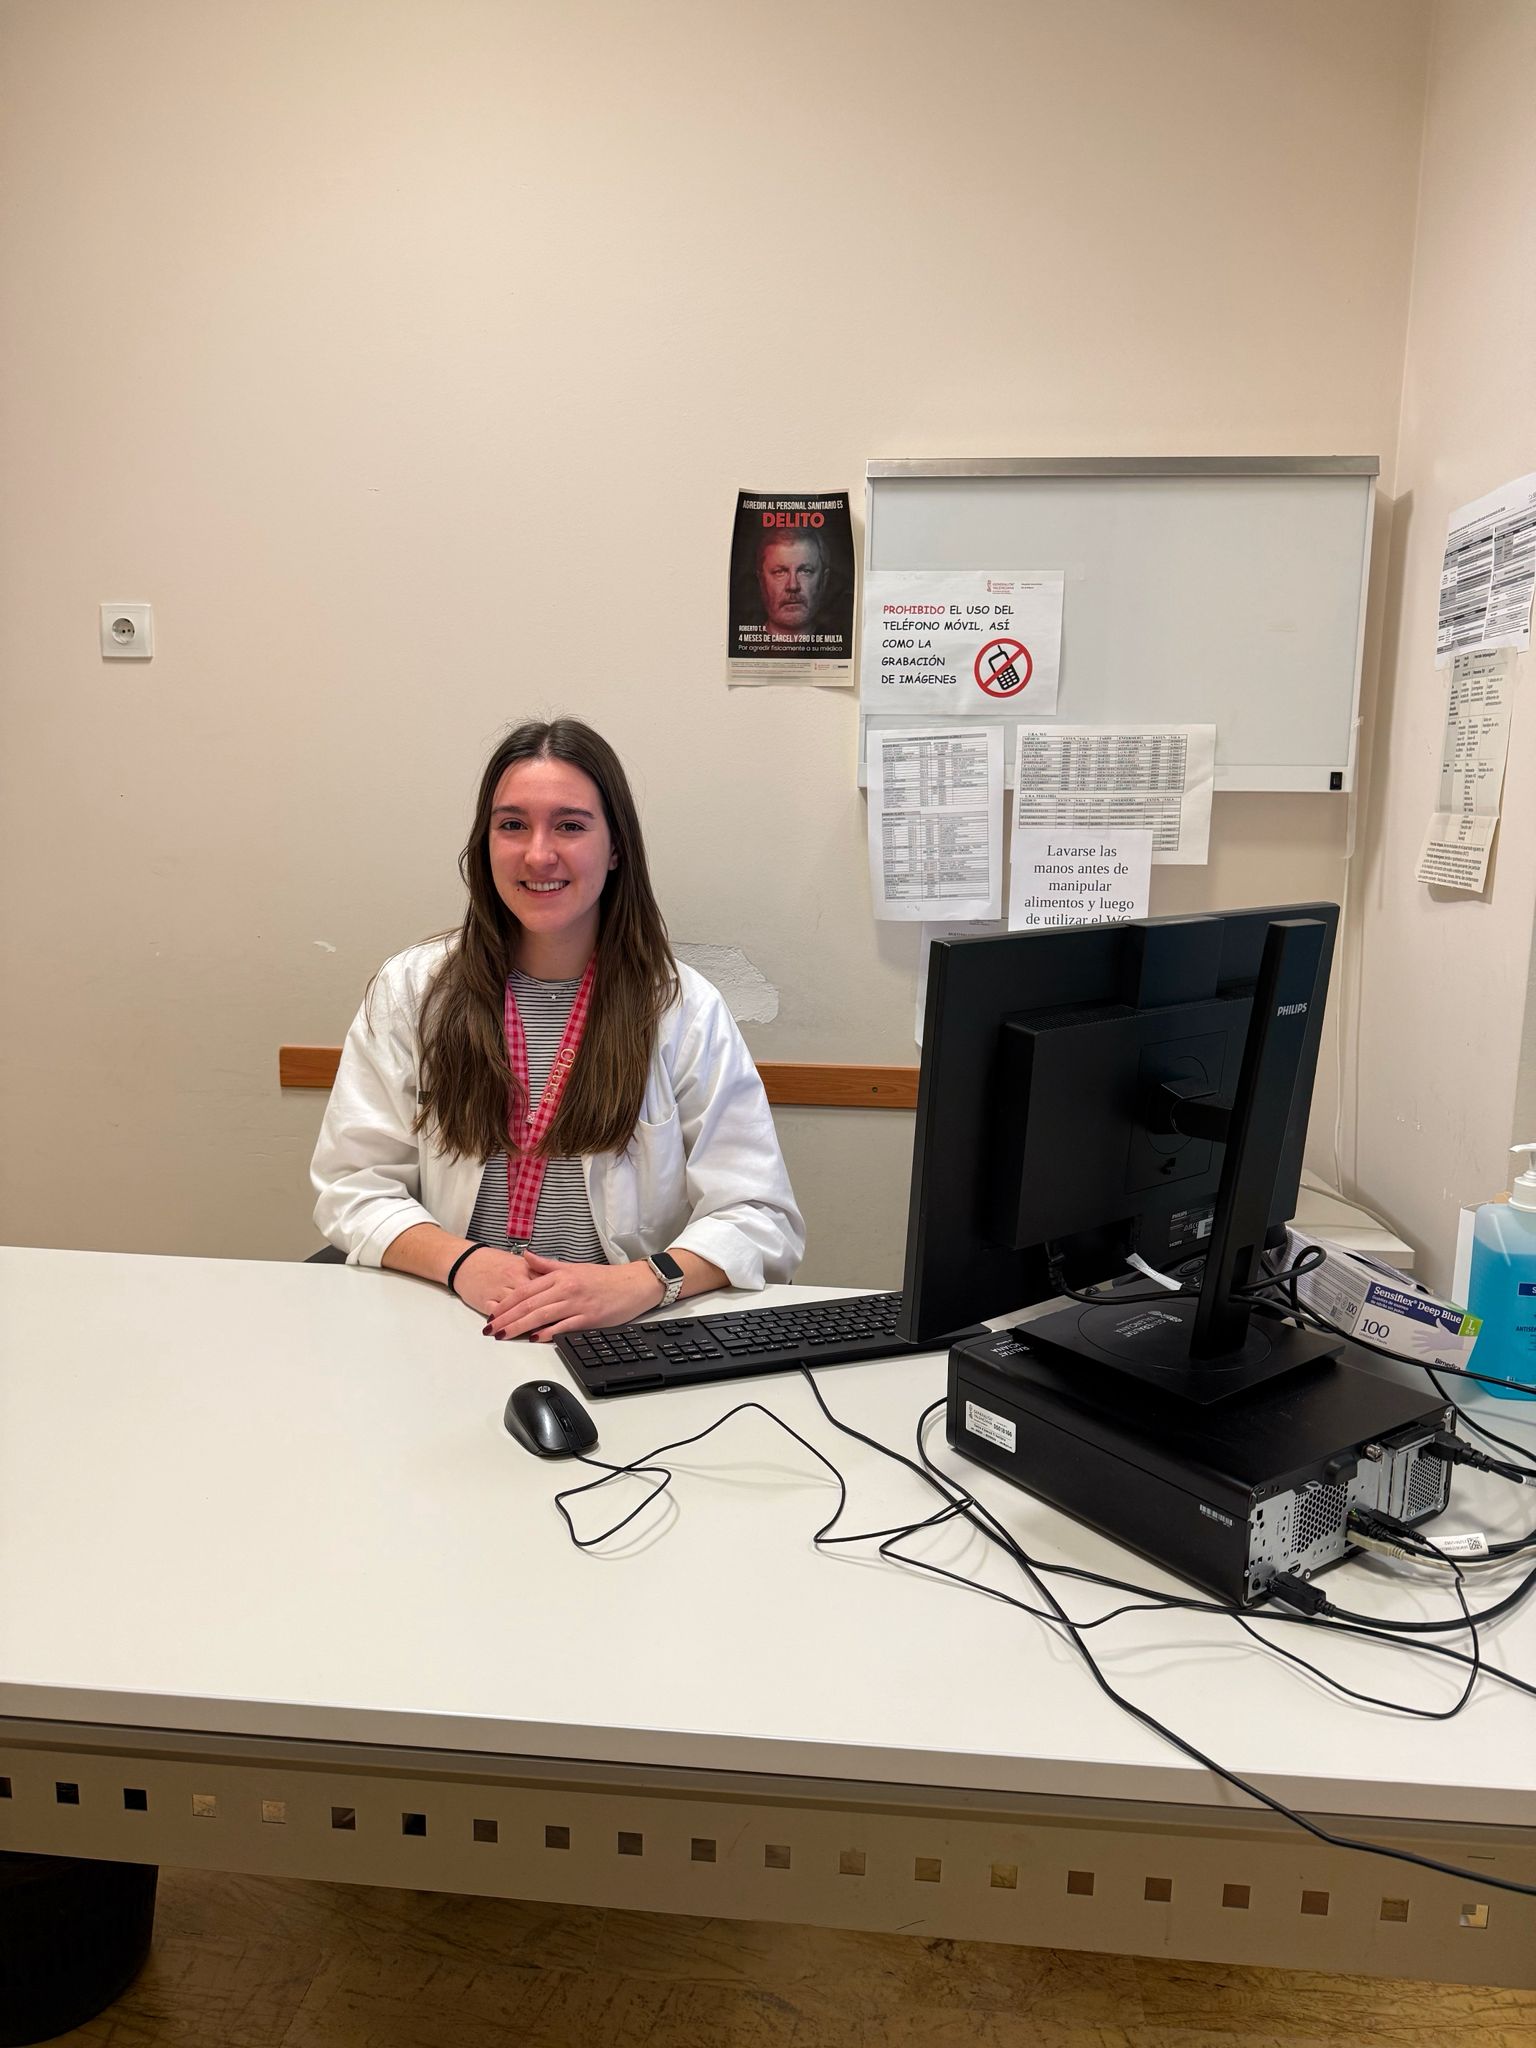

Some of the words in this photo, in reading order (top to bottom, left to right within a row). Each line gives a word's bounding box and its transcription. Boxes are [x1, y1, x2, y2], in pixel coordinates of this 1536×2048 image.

[743, 500, 766, 510] AGREDIR
[768, 502, 776, 510] AL
[776, 501, 806, 510] PERSONAL
[807, 500, 836, 510] SANITARIO
[837, 500, 844, 509] ES
[762, 512, 825, 528] DELITO
[883, 605, 946, 615] PROHIBIDO
[950, 606, 962, 615] EL
[966, 606, 990, 615] USO
[994, 606, 1014, 615] DEL
[883, 618, 940, 631] TELÉFONO
[944, 618, 984, 632] MÓVIL,
[989, 619, 1010, 631] ASÍ
[744, 634, 763, 642] MESES
[772, 632, 793, 642] CÁRCEL
[793, 634, 798, 642] Y
[824, 635, 843, 643] MULTA
[882, 640, 914, 649] COMO
[918, 640, 932, 649] LA
[881, 654, 946, 666] GRABACIÓN
[881, 675, 895, 684] DE
[899, 672, 957, 684] IMÁGENES
[1047, 845, 1096, 857] Lavarse
[1100, 845, 1117, 857] las
[1034, 864, 1074, 874] manos
[1078, 864, 1110, 874] antes
[1114, 863, 1129, 874] de
[1048, 880, 1112, 894] manipular
[1024, 896, 1084, 908] alimentos
[1088, 900, 1096, 911] y
[1100, 897, 1134, 912] luego
[1026, 913, 1040, 925] de
[1044, 914, 1088, 925] utilizar
[1092, 915, 1102, 924] el
[1277, 1002, 1307, 1016] PHILIPS
[544, 1048, 576, 1102] Clara
[1346, 1302, 1357, 1315] 100
[1417, 1302, 1441, 1317] Deep
[1441, 1311, 1462, 1324] Blue
[1361, 1319, 1390, 1338] 100
[1468, 1319, 1474, 1330] L
